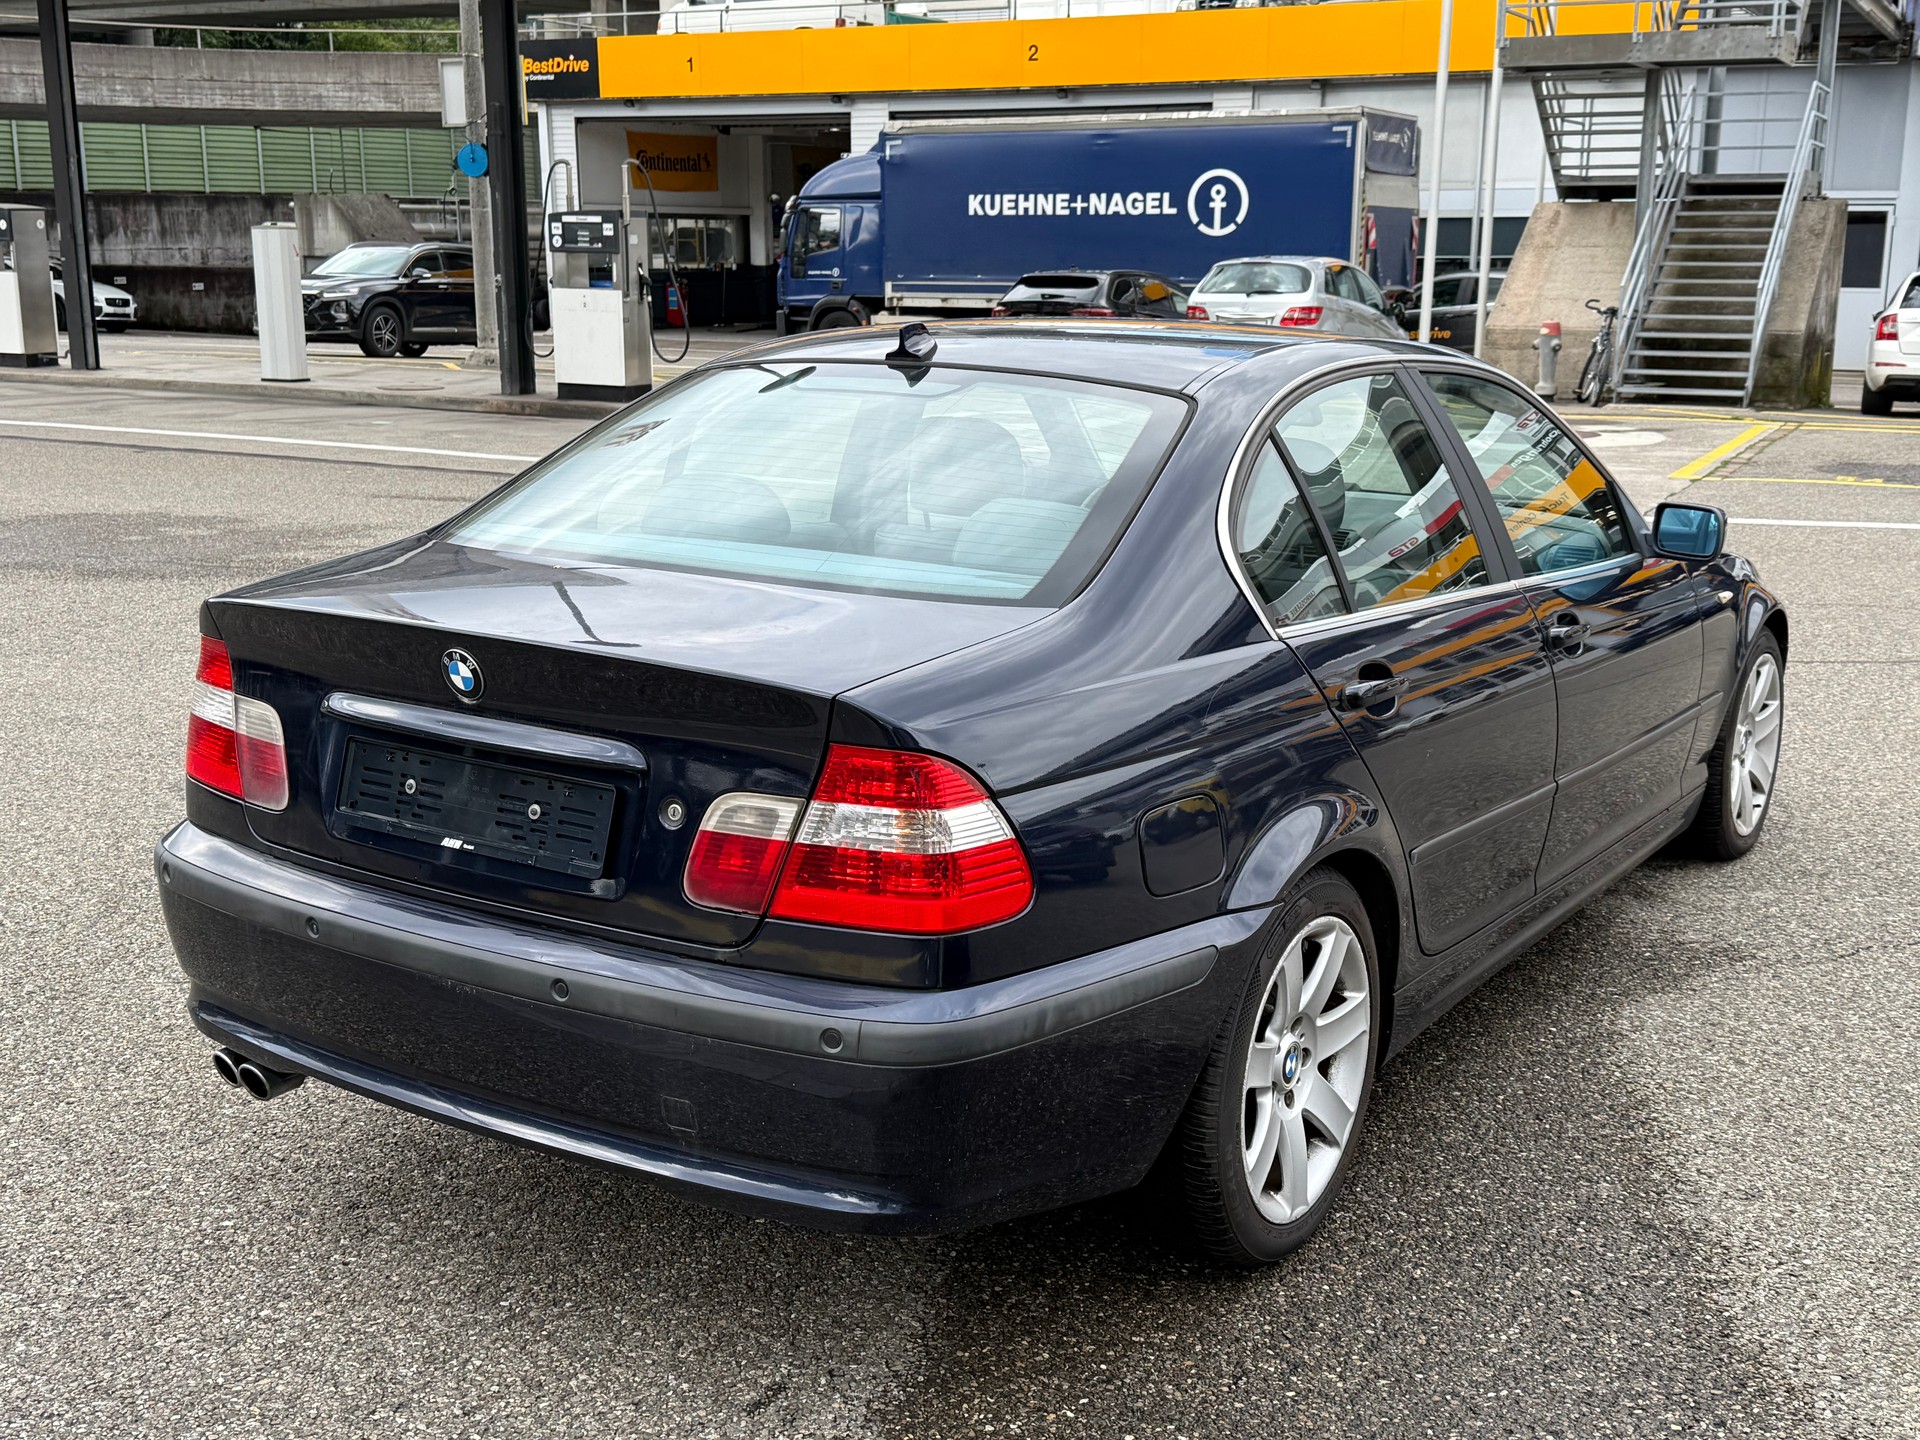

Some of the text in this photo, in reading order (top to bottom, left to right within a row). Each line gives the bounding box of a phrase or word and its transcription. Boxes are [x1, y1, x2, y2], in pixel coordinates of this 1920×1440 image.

[1028, 44, 1039, 61] 2
[524, 54, 590, 74] BestDrive
[686, 56, 693, 72] 1
[636, 149, 702, 173] Continental
[968, 192, 1178, 216] KUEHNE+NAGEL
[1408, 327, 1452, 339] strive
[443, 652, 475, 670] BMW
